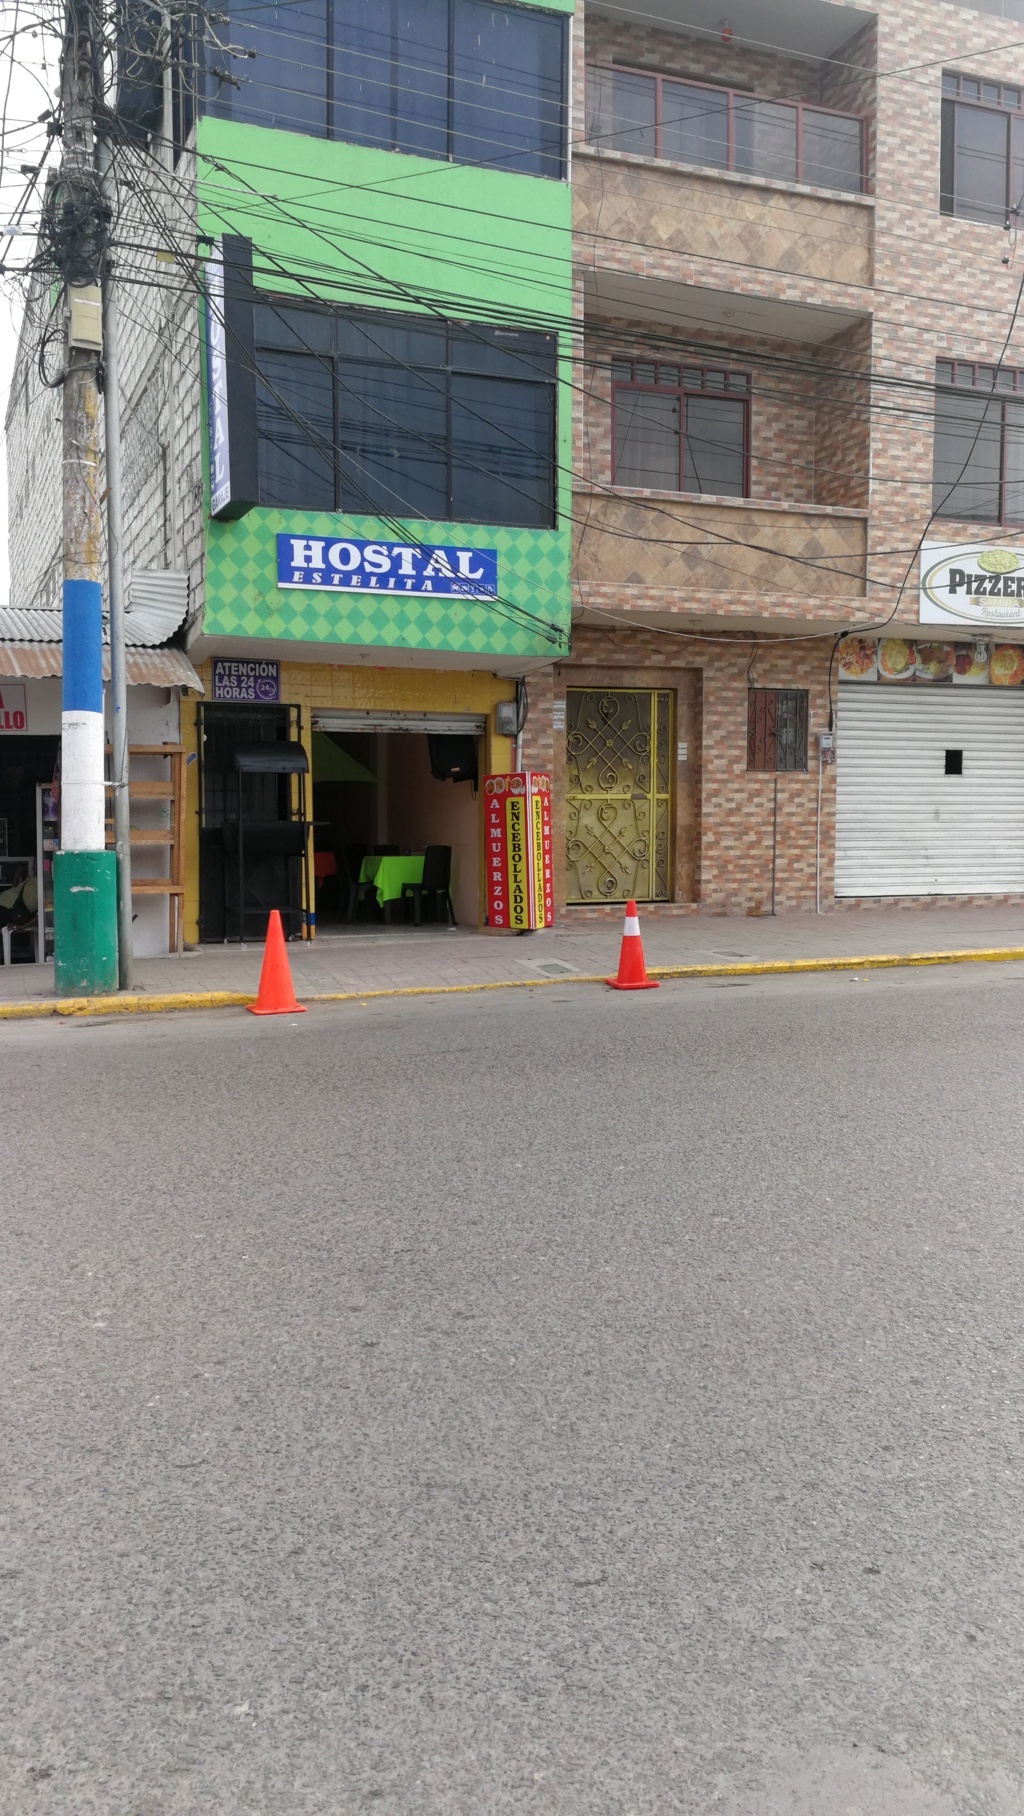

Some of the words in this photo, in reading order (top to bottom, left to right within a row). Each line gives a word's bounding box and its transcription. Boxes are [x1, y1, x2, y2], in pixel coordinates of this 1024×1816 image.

[290, 538, 484, 579] HOSTAL
[292, 571, 433, 591] ESTELITA
[979, 598, 1020, 607] SAMIRA
[982, 607, 1021, 618] Restaurant
[216, 661, 277, 677] ATENCIÓN
[215, 675, 238, 687] LAS
[241, 677, 255, 687] 24
[215, 687, 255, 699] HORAS
[490, 799, 504, 925] ALMUERZOS
[510, 801, 524, 925] ENCEBOLLADOS
[535, 800, 543, 923] ENCEBOLLADOS
[543, 797, 552, 922] ALMUERZOS
